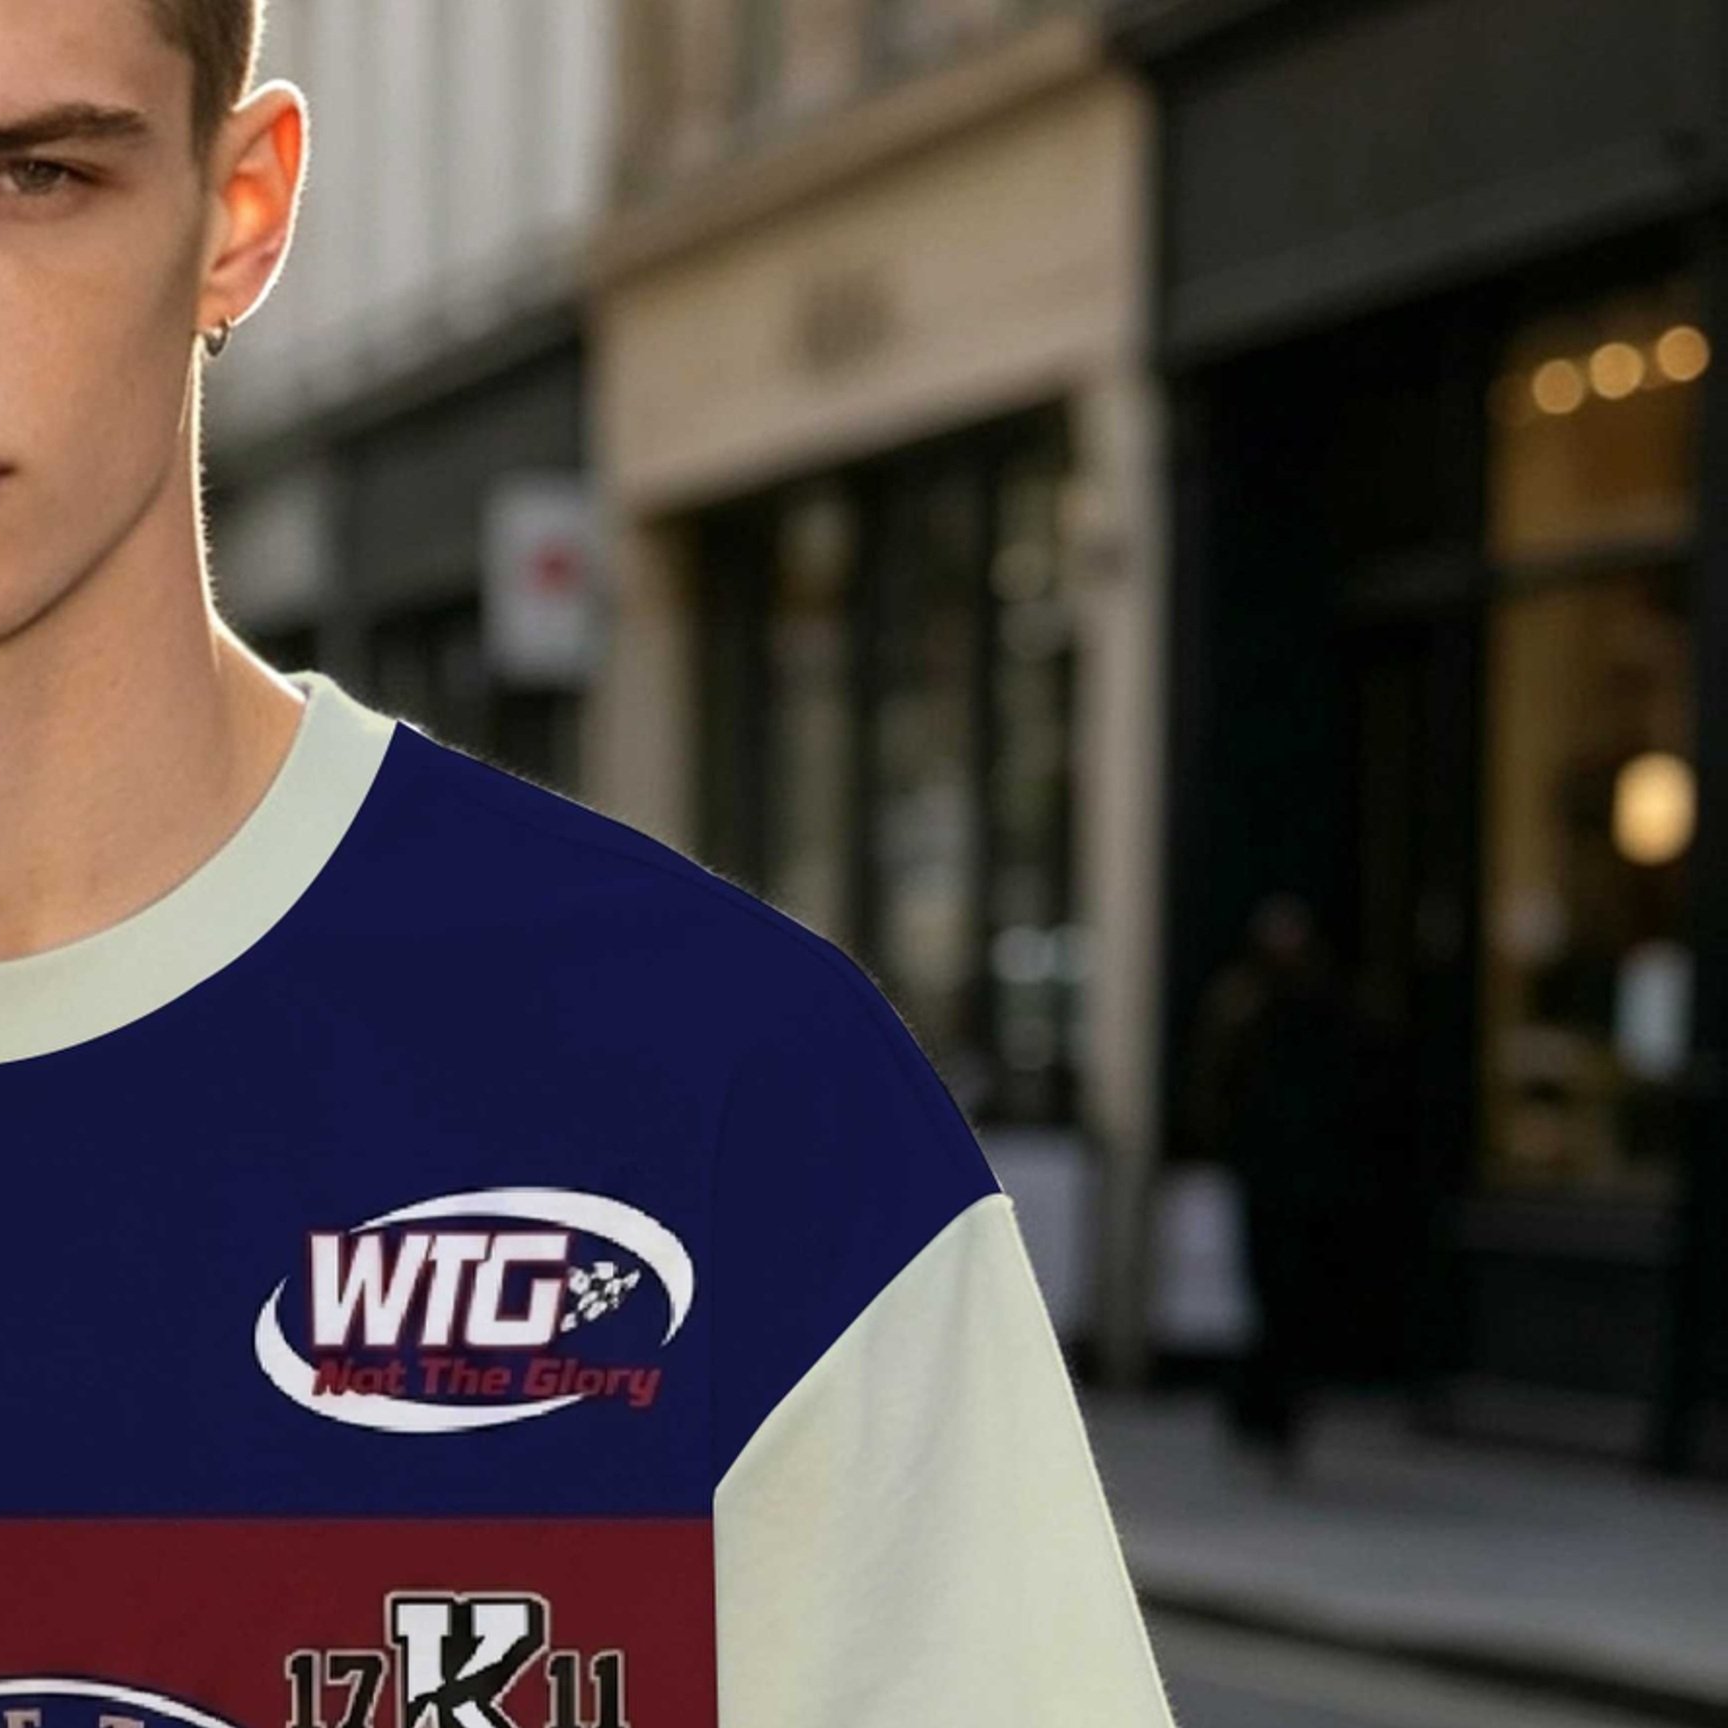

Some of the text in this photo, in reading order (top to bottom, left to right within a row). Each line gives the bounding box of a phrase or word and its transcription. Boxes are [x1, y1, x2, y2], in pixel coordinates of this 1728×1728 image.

[308, 1230, 570, 1349] WTG
[312, 1356, 662, 1408] Not The Glory
